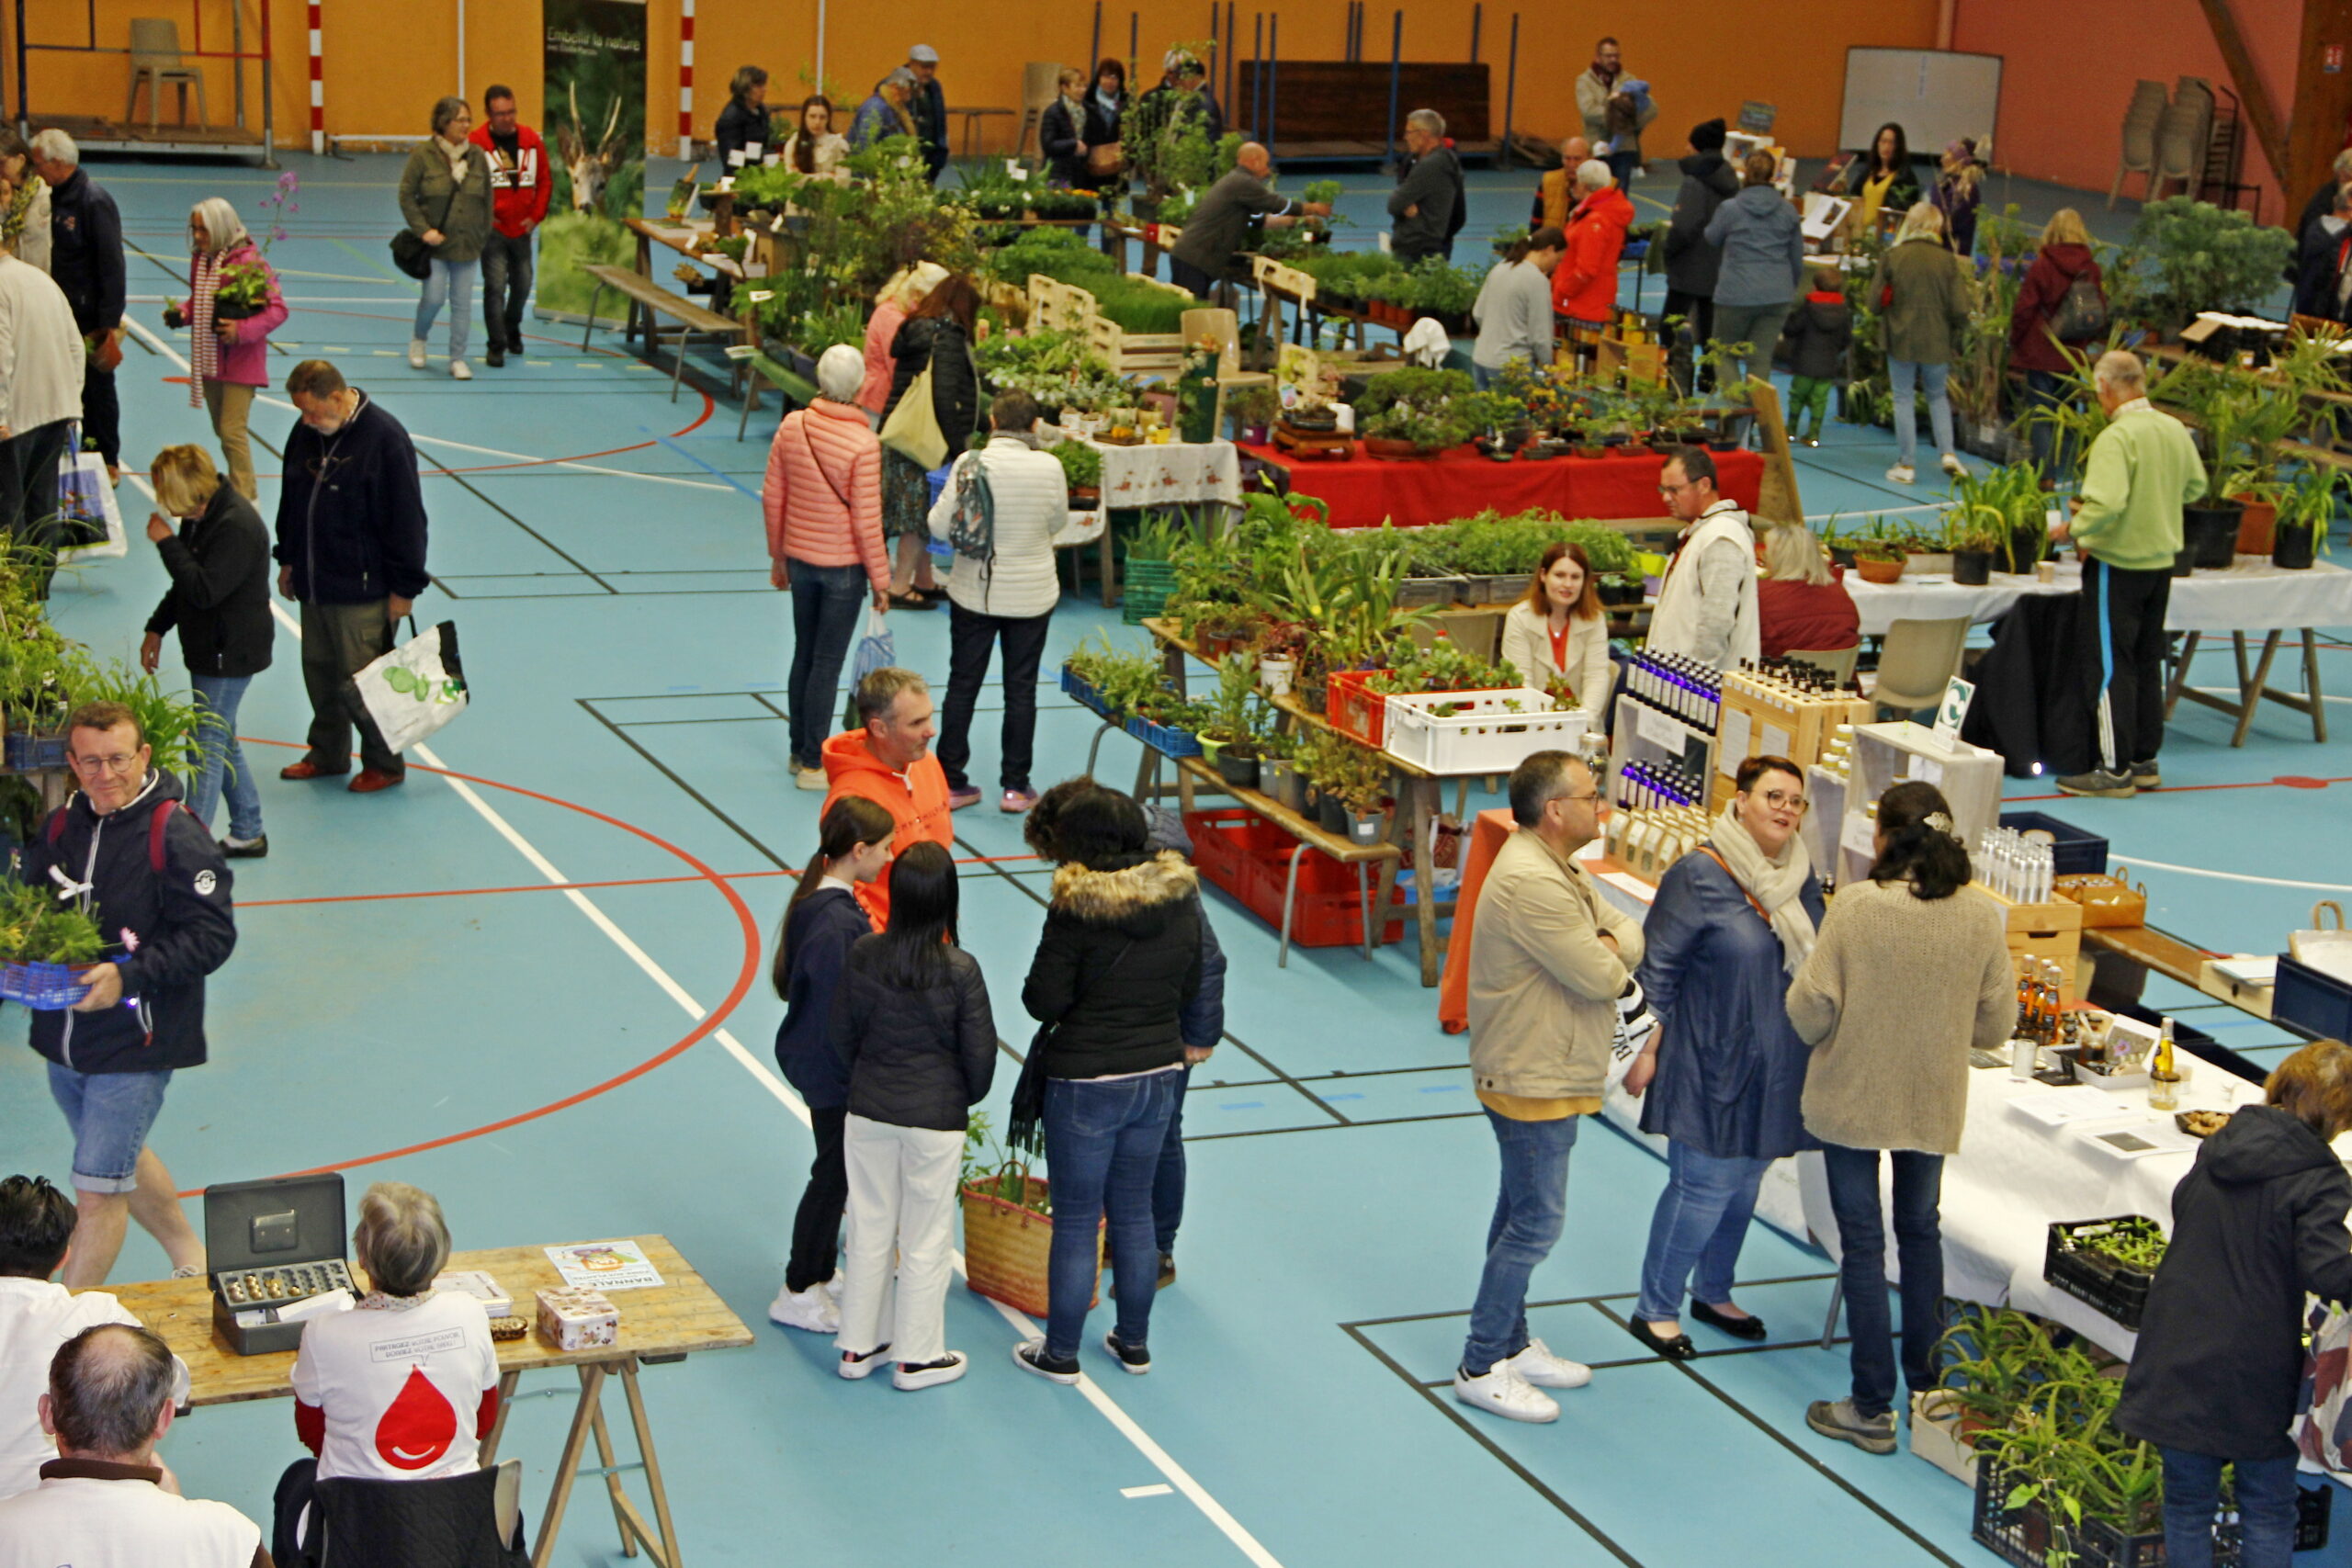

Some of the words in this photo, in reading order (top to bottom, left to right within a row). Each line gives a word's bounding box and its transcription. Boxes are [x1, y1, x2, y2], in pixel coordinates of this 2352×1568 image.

[547, 27, 589, 45] Embellir
[593, 32, 602, 47] la
[605, 38, 640, 51] nature
[593, 1277, 653, 1287] BANNALE
